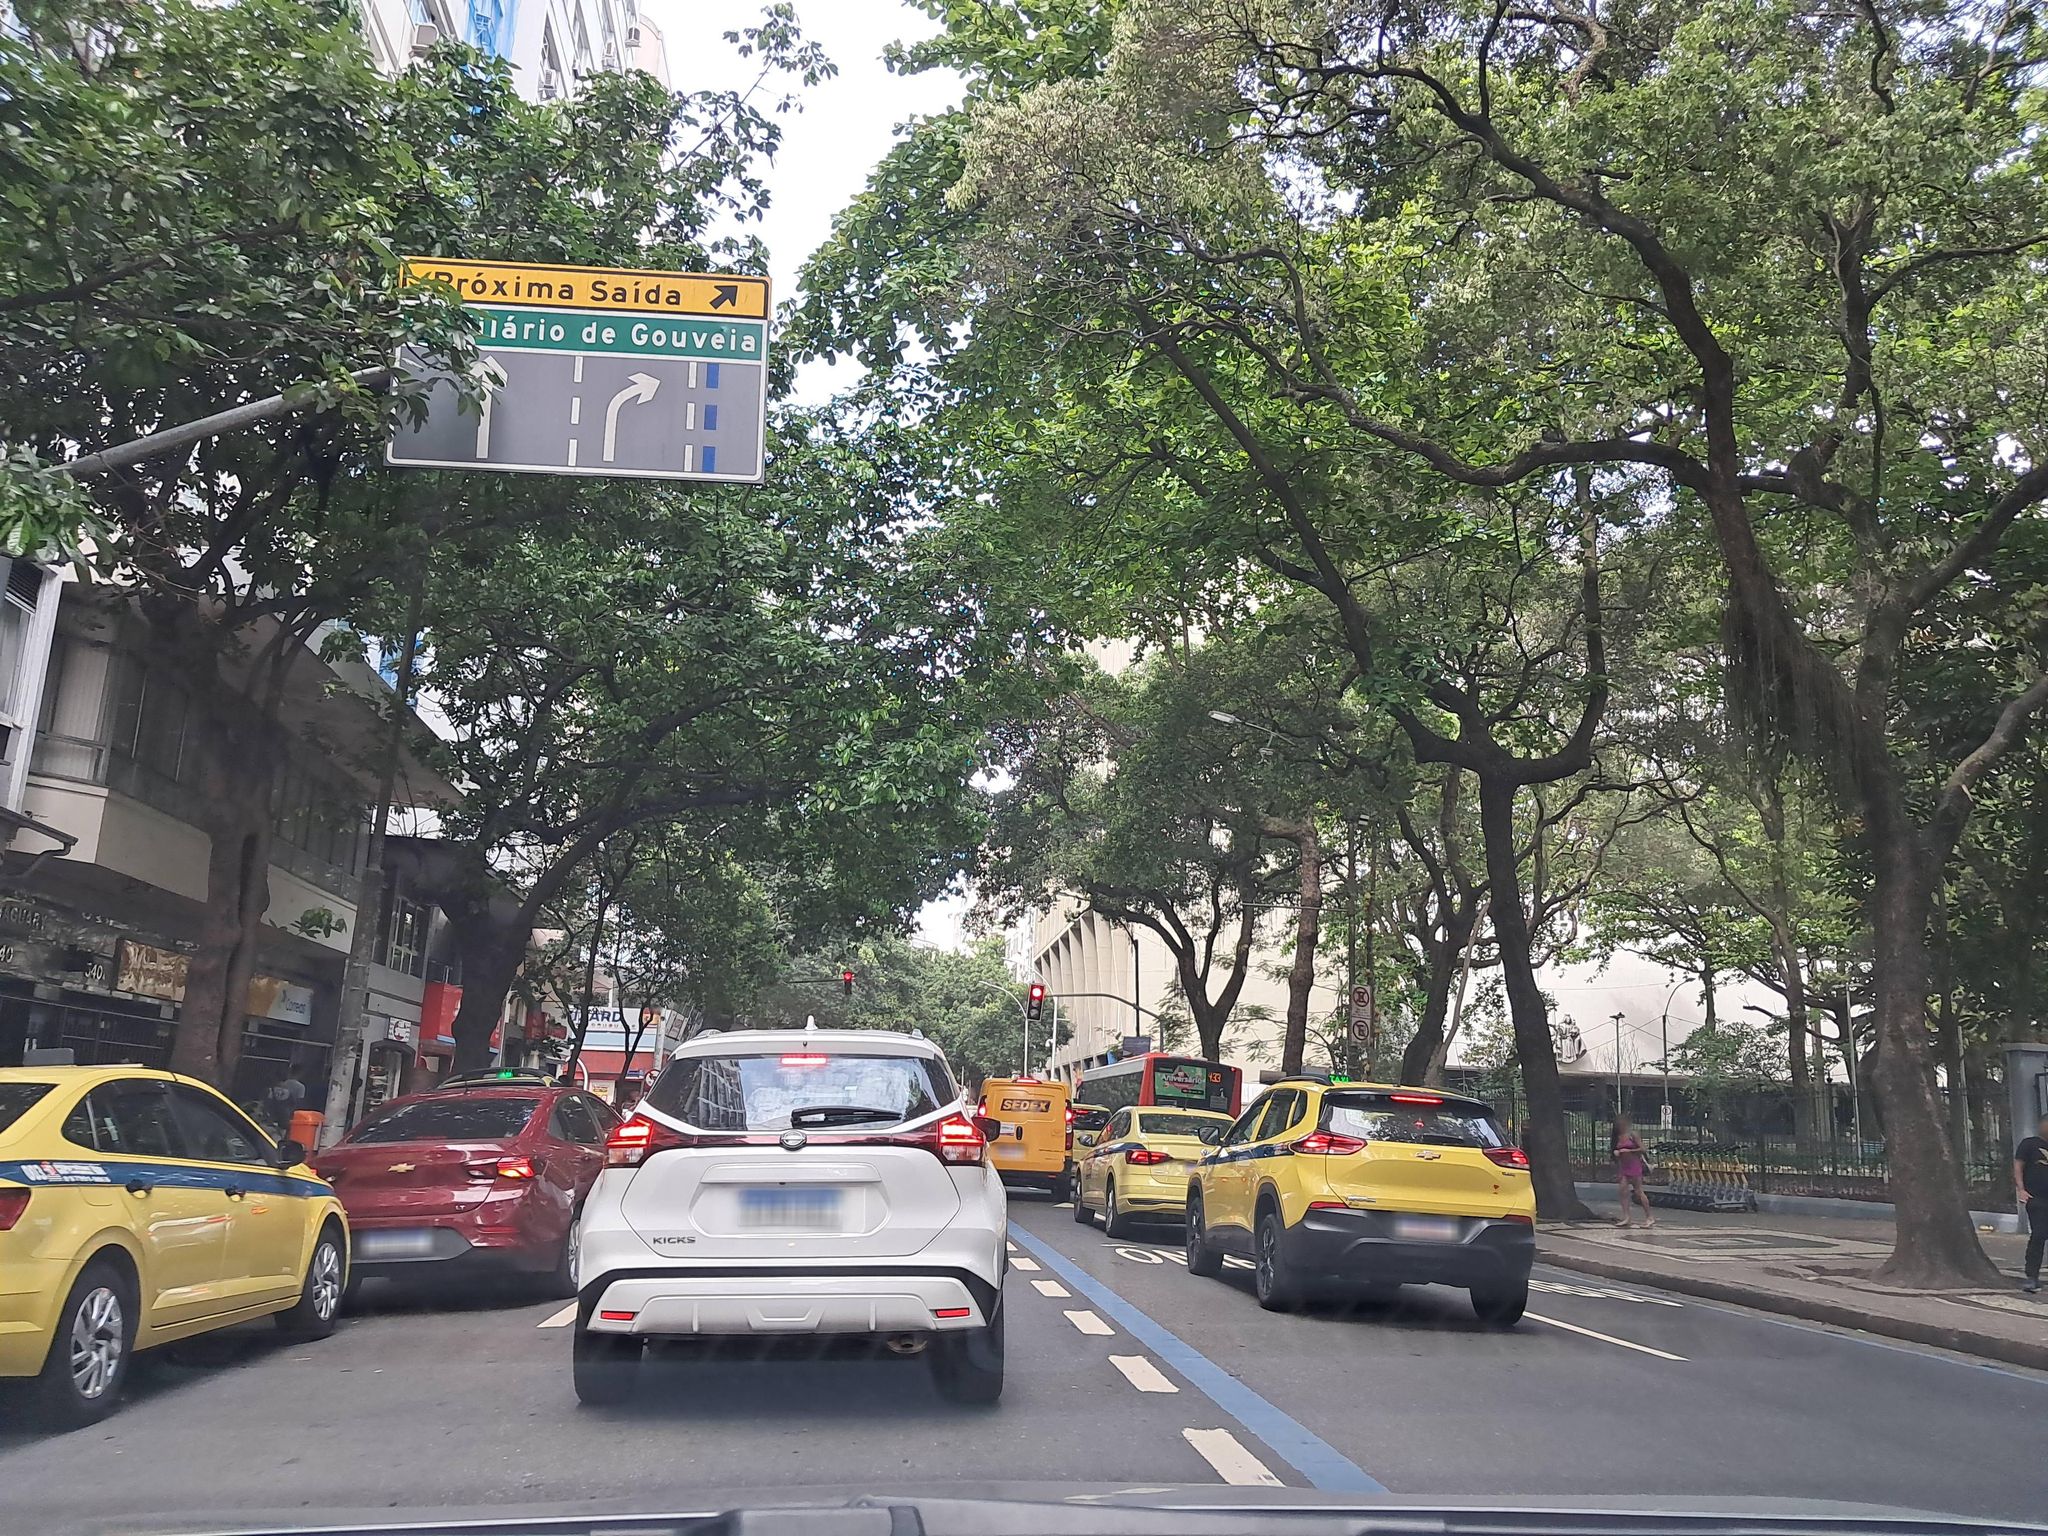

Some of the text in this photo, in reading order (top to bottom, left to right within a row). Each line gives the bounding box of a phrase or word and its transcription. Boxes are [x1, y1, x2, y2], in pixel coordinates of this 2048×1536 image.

[435, 271, 681, 306] Próxima Saída
[479, 315, 756, 352] ilário de Gouveia
[1001, 1100, 1049, 1113] SEDEX
[652, 1236, 696, 1244] KICKS
